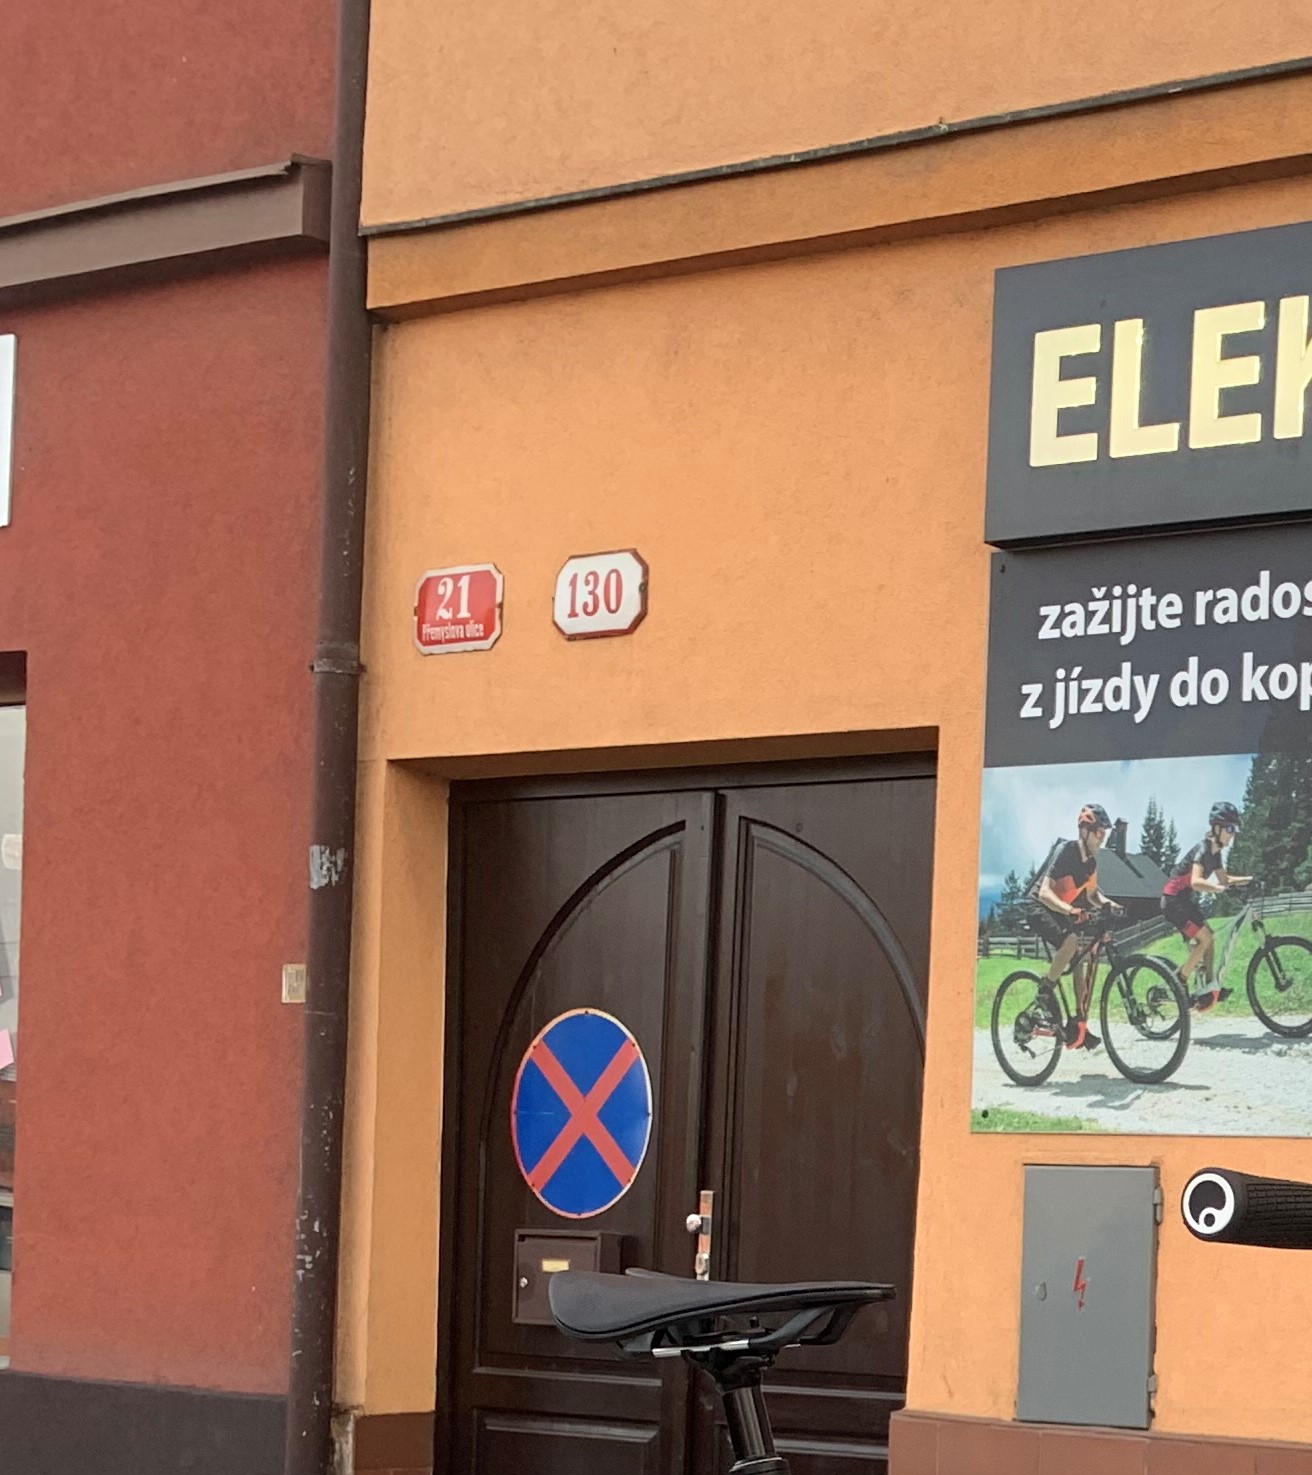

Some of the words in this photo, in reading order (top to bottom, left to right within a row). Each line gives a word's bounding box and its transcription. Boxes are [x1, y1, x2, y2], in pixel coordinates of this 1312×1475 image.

[436, 575, 472, 621] 21
[567, 568, 623, 619] 130
[1038, 584, 1183, 645] zažijte
[1020, 682, 1043, 719] z
[1049, 662, 1160, 729] jízdy
[1170, 656, 1229, 708] do
